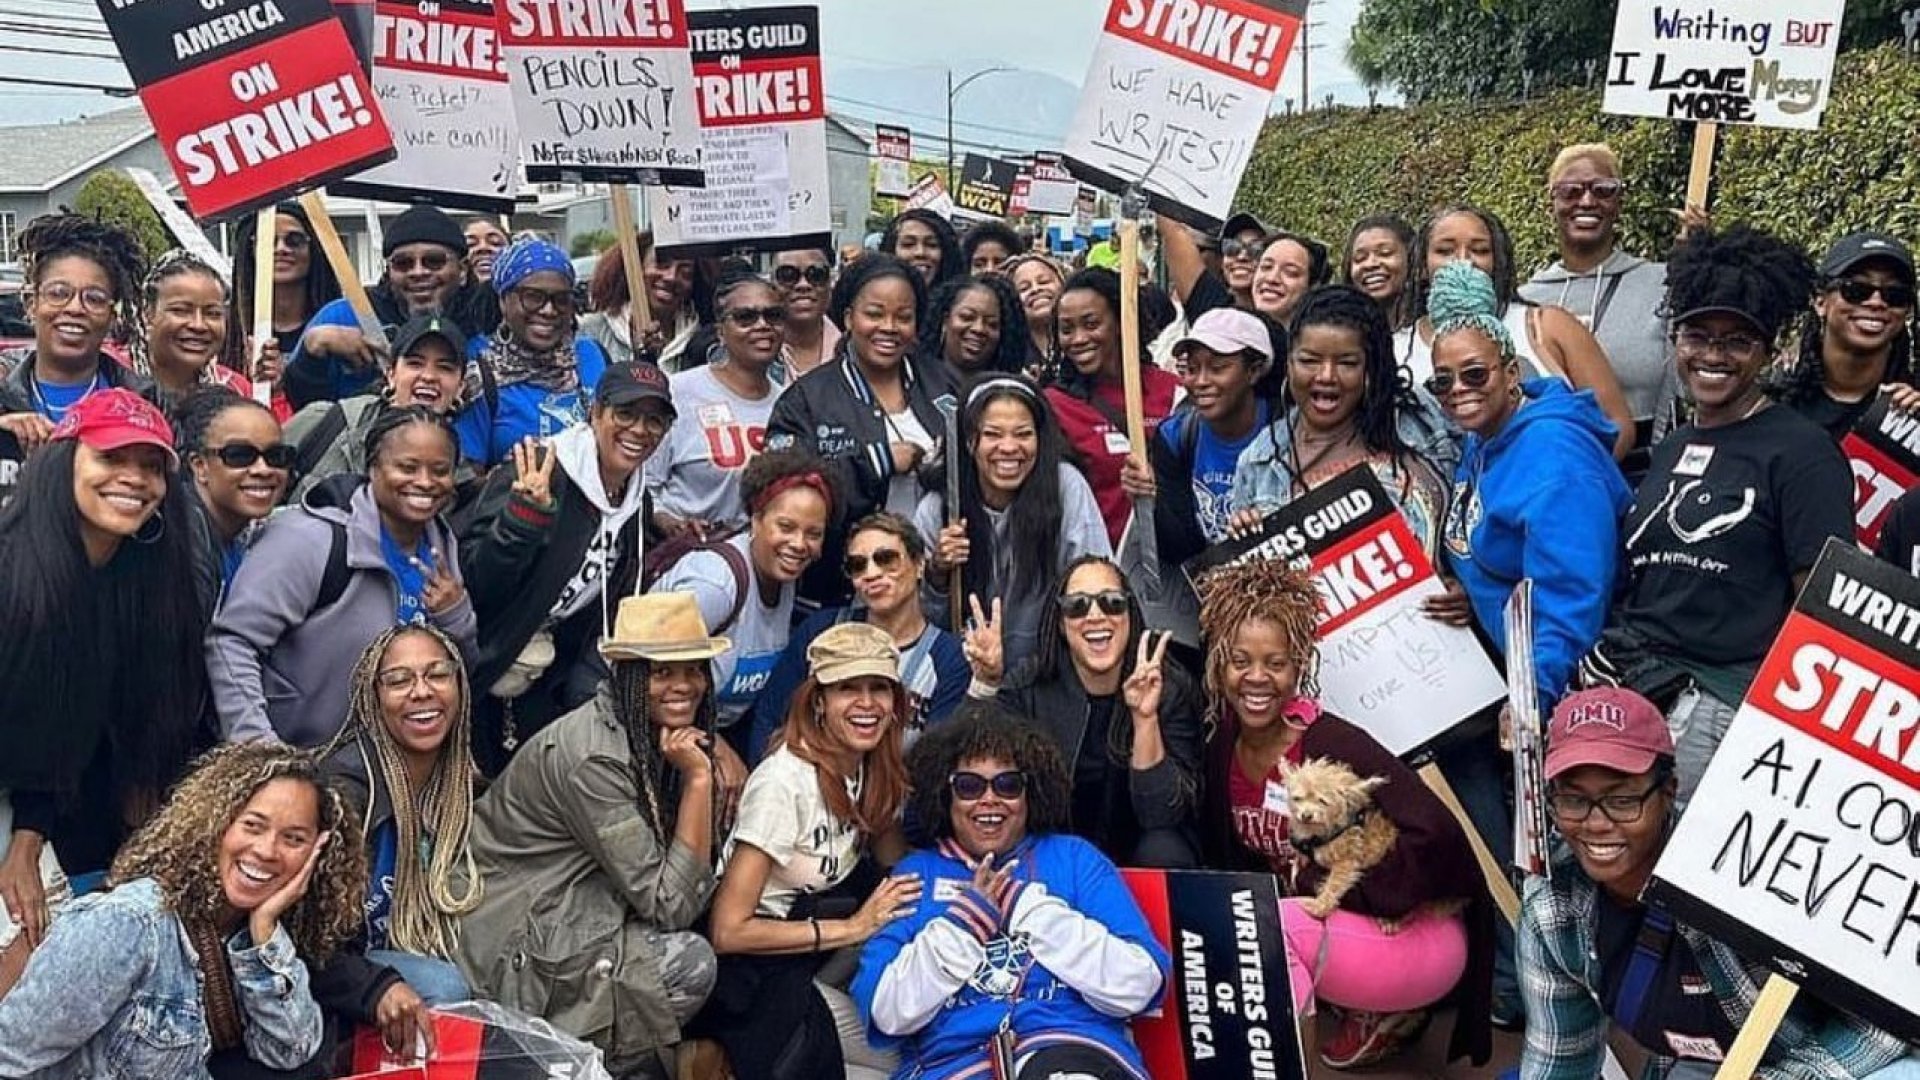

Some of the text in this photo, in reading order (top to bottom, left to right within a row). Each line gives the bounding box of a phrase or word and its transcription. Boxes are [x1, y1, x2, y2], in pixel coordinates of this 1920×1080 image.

[171, 4, 286, 60] AMERICA
[418, 1, 440, 16] ON
[507, 0, 673, 39] STRIKE!
[374, 14, 508, 74] TRIKE!
[691, 24, 807, 52] TERS GUILD
[1117, 0, 1282, 77] STRIKE!
[1784, 20, 1834, 45] BUT
[230, 61, 280, 103] ON
[720, 56, 741, 70] ON
[1608, 52, 1641, 86] I
[702, 67, 812, 119] RIKE!
[1109, 65, 1243, 120] WE HAVE
[1666, 92, 1756, 122] MORE
[174, 73, 373, 187] STRIKE!
[960, 190, 1004, 216] WGA
[1234, 488, 1373, 567] TERS GUILD
[1312, 531, 1414, 624] IKE!
[1231, 888, 1268, 1022] WRITERS
[1180, 928, 1216, 1061] AMERICA
[1214, 981, 1236, 1015] OF
